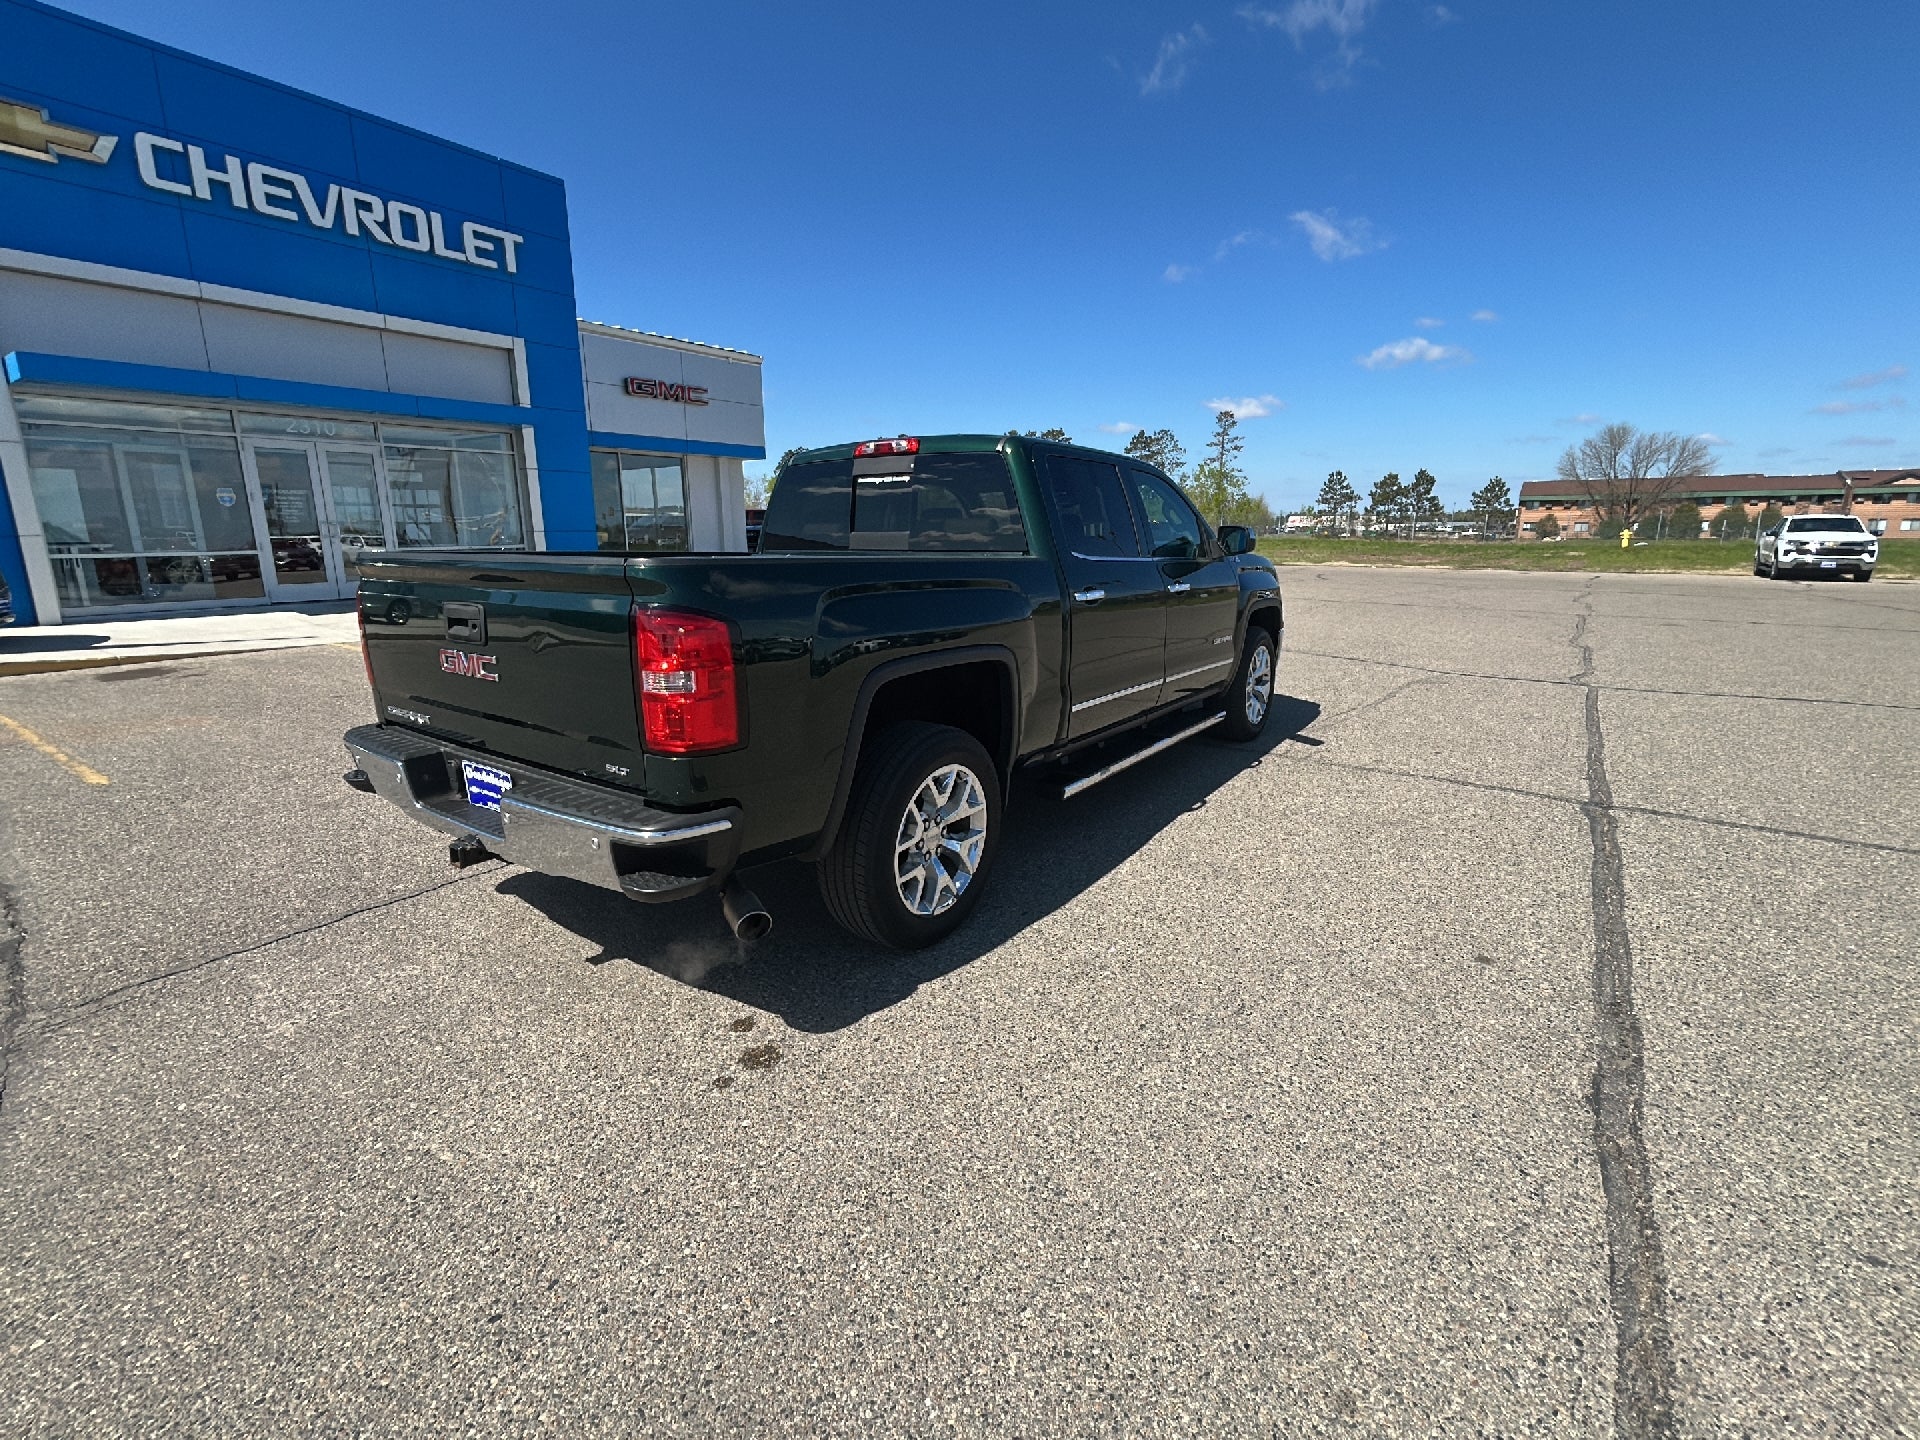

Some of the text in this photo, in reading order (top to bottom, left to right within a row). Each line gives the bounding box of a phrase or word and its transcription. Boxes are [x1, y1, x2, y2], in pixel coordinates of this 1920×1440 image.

[134, 131, 524, 273] CHEVROLET
[624, 375, 709, 407] GMC
[439, 648, 499, 682] GMC
